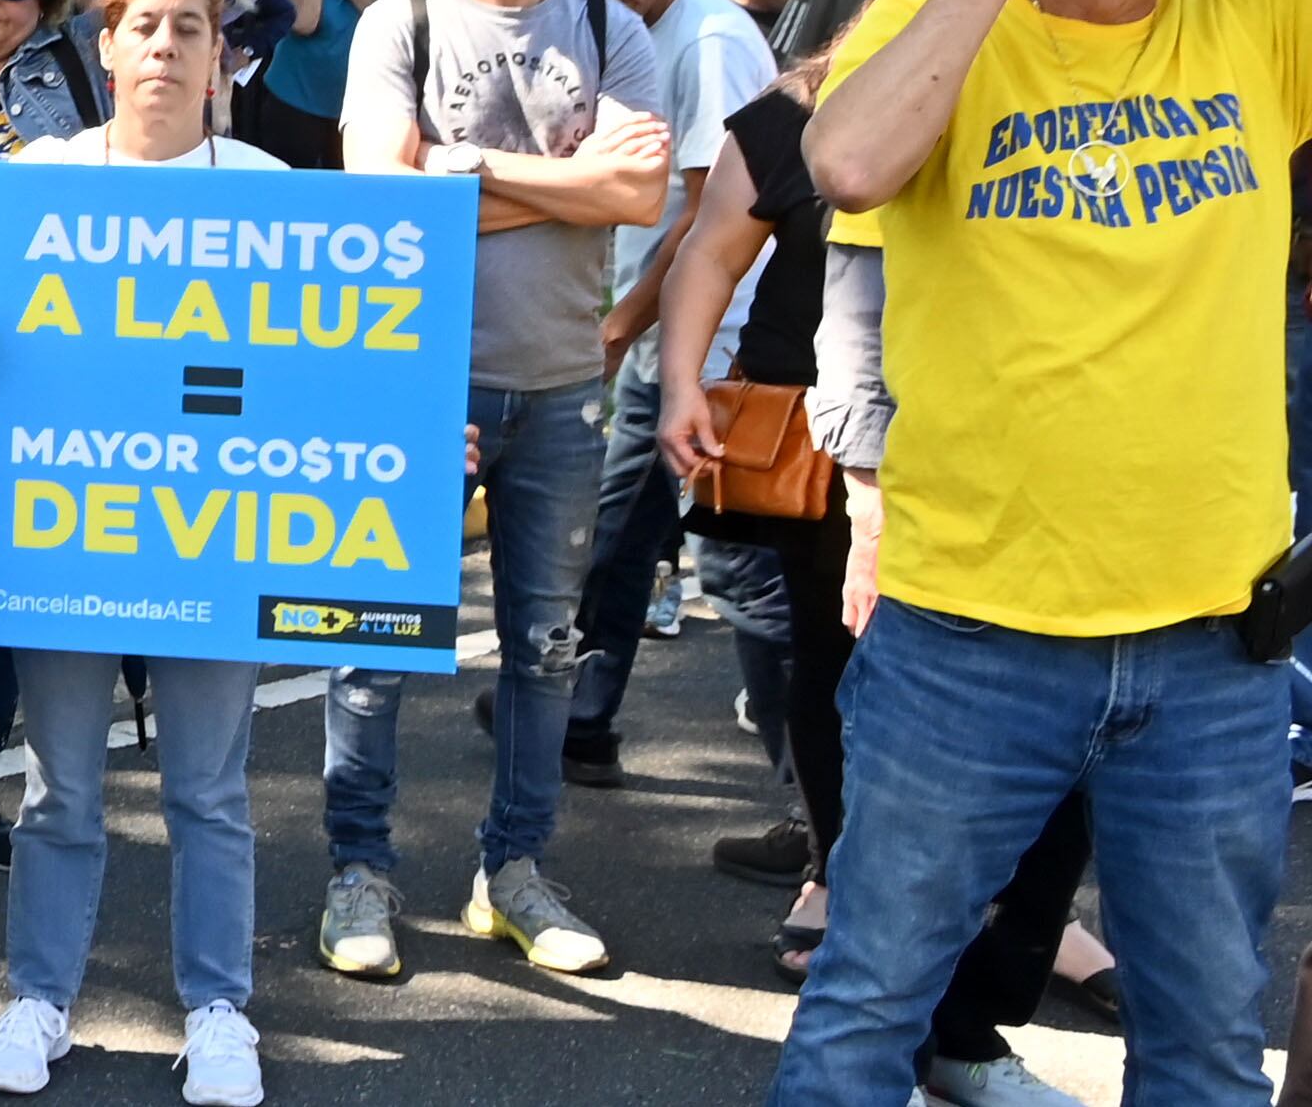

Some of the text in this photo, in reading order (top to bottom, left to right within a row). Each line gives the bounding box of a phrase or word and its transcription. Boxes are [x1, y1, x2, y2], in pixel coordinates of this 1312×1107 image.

[1034, 94, 1198, 154] DEFENSA
[17, 273, 421, 351] A LA LUZ
[10, 427, 198, 476] MAYOR
[12, 479, 411, 572] DE VIDA
[359, 624, 421, 635] A LA LUZ
